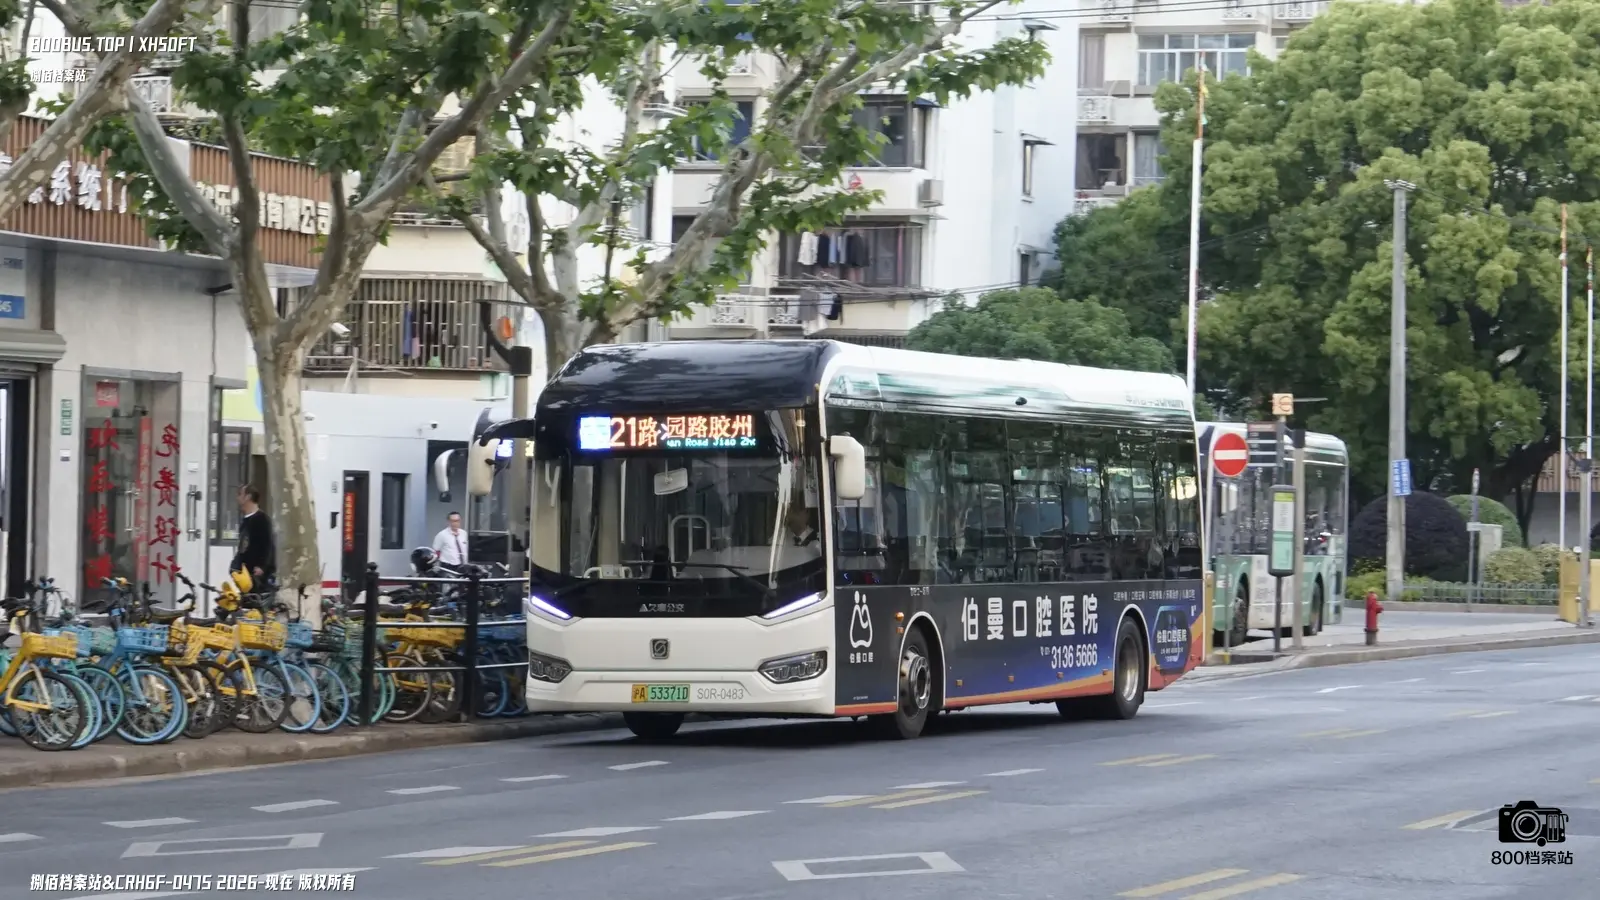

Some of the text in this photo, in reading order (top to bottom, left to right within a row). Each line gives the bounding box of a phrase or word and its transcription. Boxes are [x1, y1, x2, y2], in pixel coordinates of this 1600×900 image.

[667, 415, 753, 438] 园路胶州
[685, 438, 709, 447] Road
[713, 437, 737, 446] Jiao
[148, 423, 181, 586] 免费设计
[961, 592, 1098, 642] 伯曼口腔医院
[850, 652, 874, 663] 伯曼口腔
[1051, 645, 1074, 669] 3136
[1076, 643, 1098, 667] 5666
[650, 686, 689, 699] 53371D
